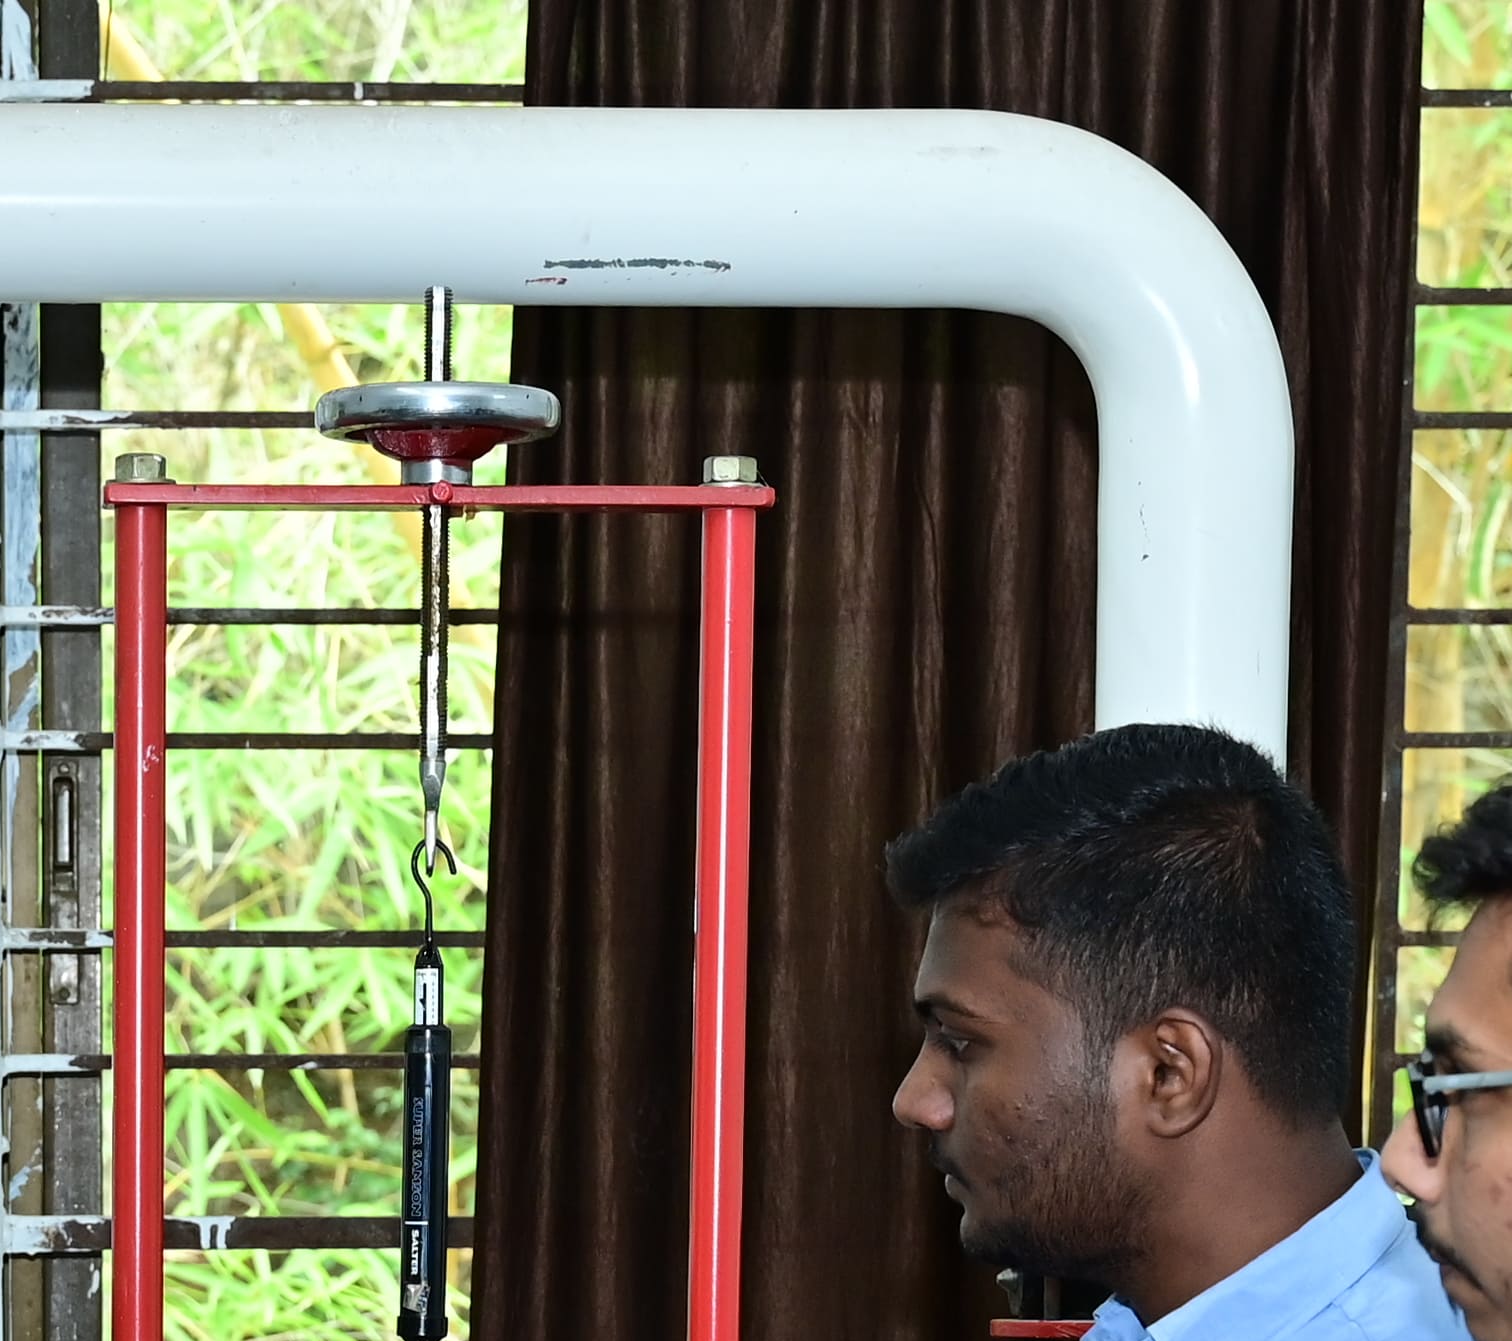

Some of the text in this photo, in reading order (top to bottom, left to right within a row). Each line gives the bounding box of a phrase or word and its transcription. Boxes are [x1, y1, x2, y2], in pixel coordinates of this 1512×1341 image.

[411, 1096, 424, 1217] SUPER SAMSON
[410, 1229, 420, 1276] SALTER
